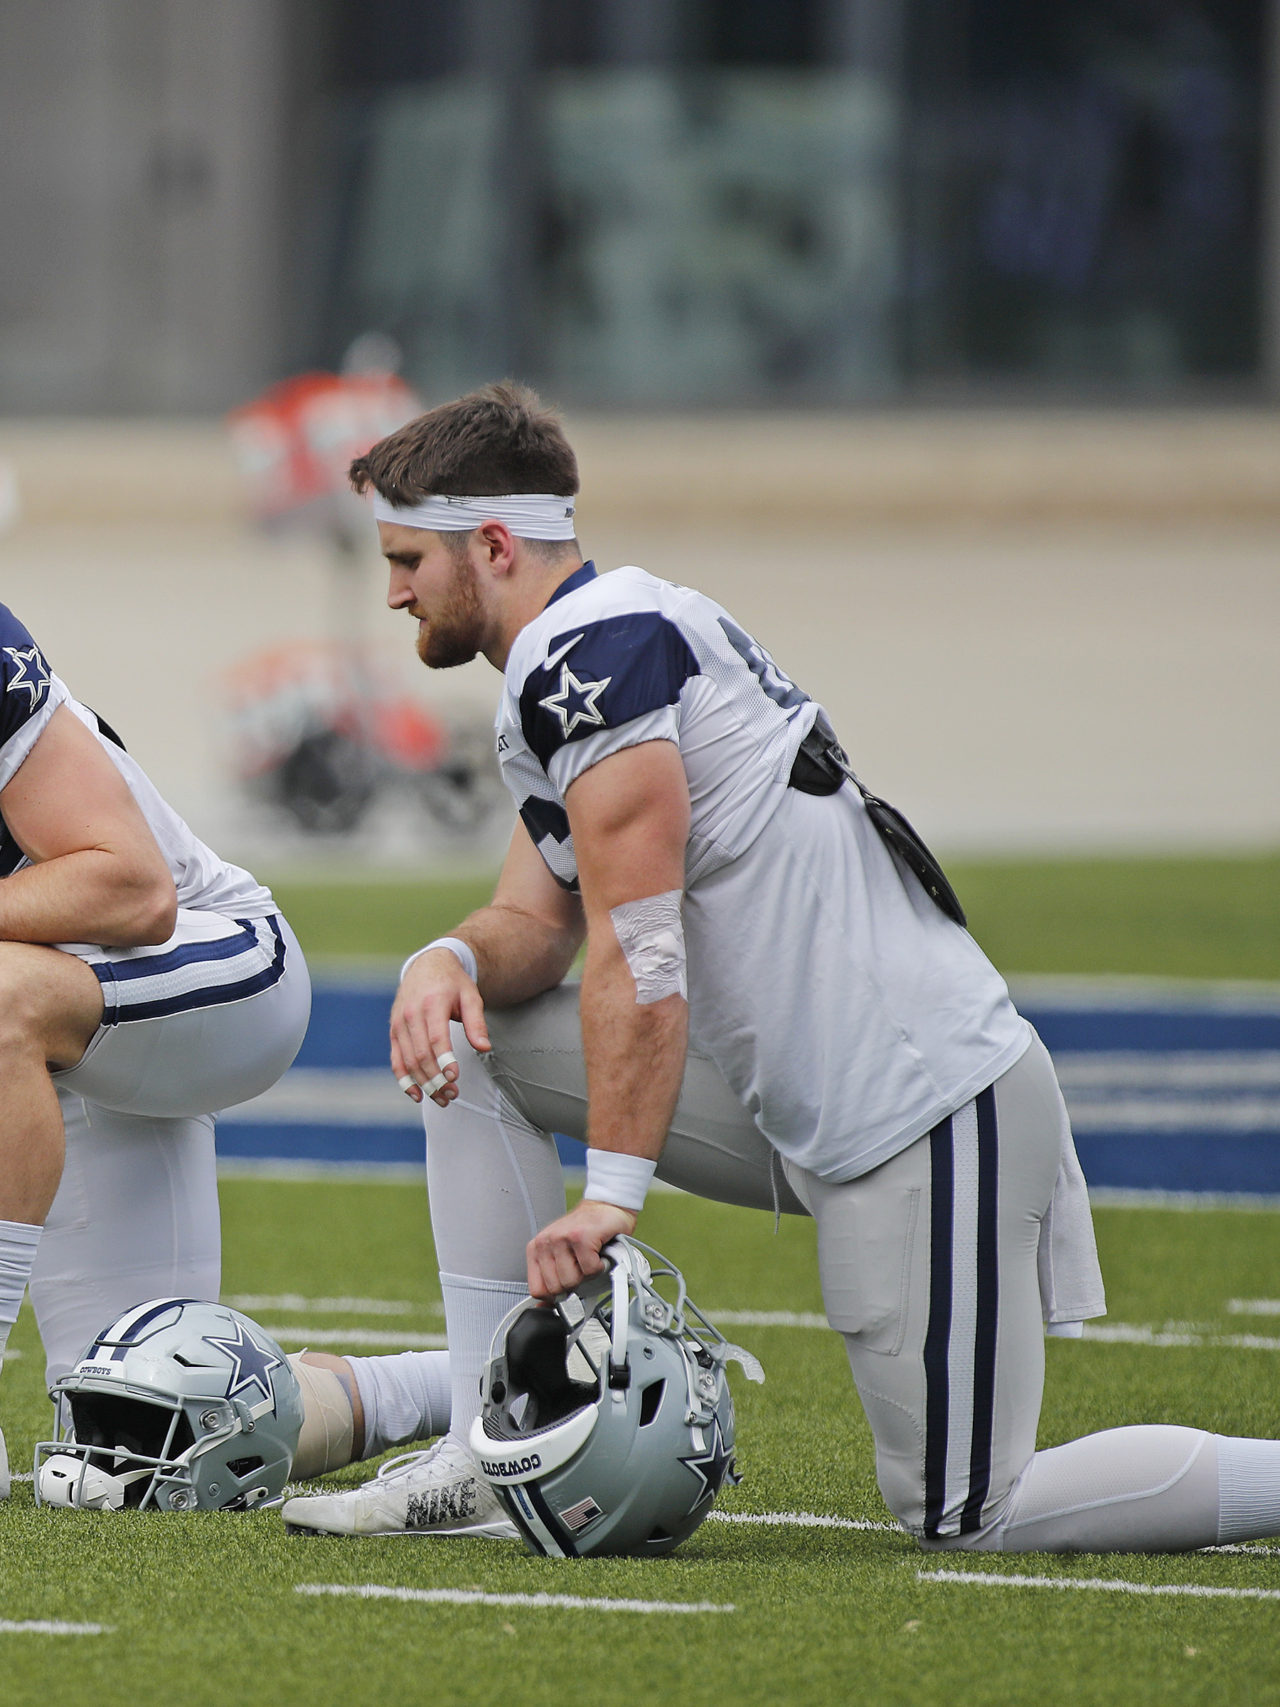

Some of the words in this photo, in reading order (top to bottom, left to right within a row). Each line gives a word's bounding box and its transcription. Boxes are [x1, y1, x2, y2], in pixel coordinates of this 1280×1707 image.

[80, 1366, 112, 1376] COWBOYS
[481, 1453, 542, 1477] COWBOYS
[405, 1477, 477, 1529] NIKE
